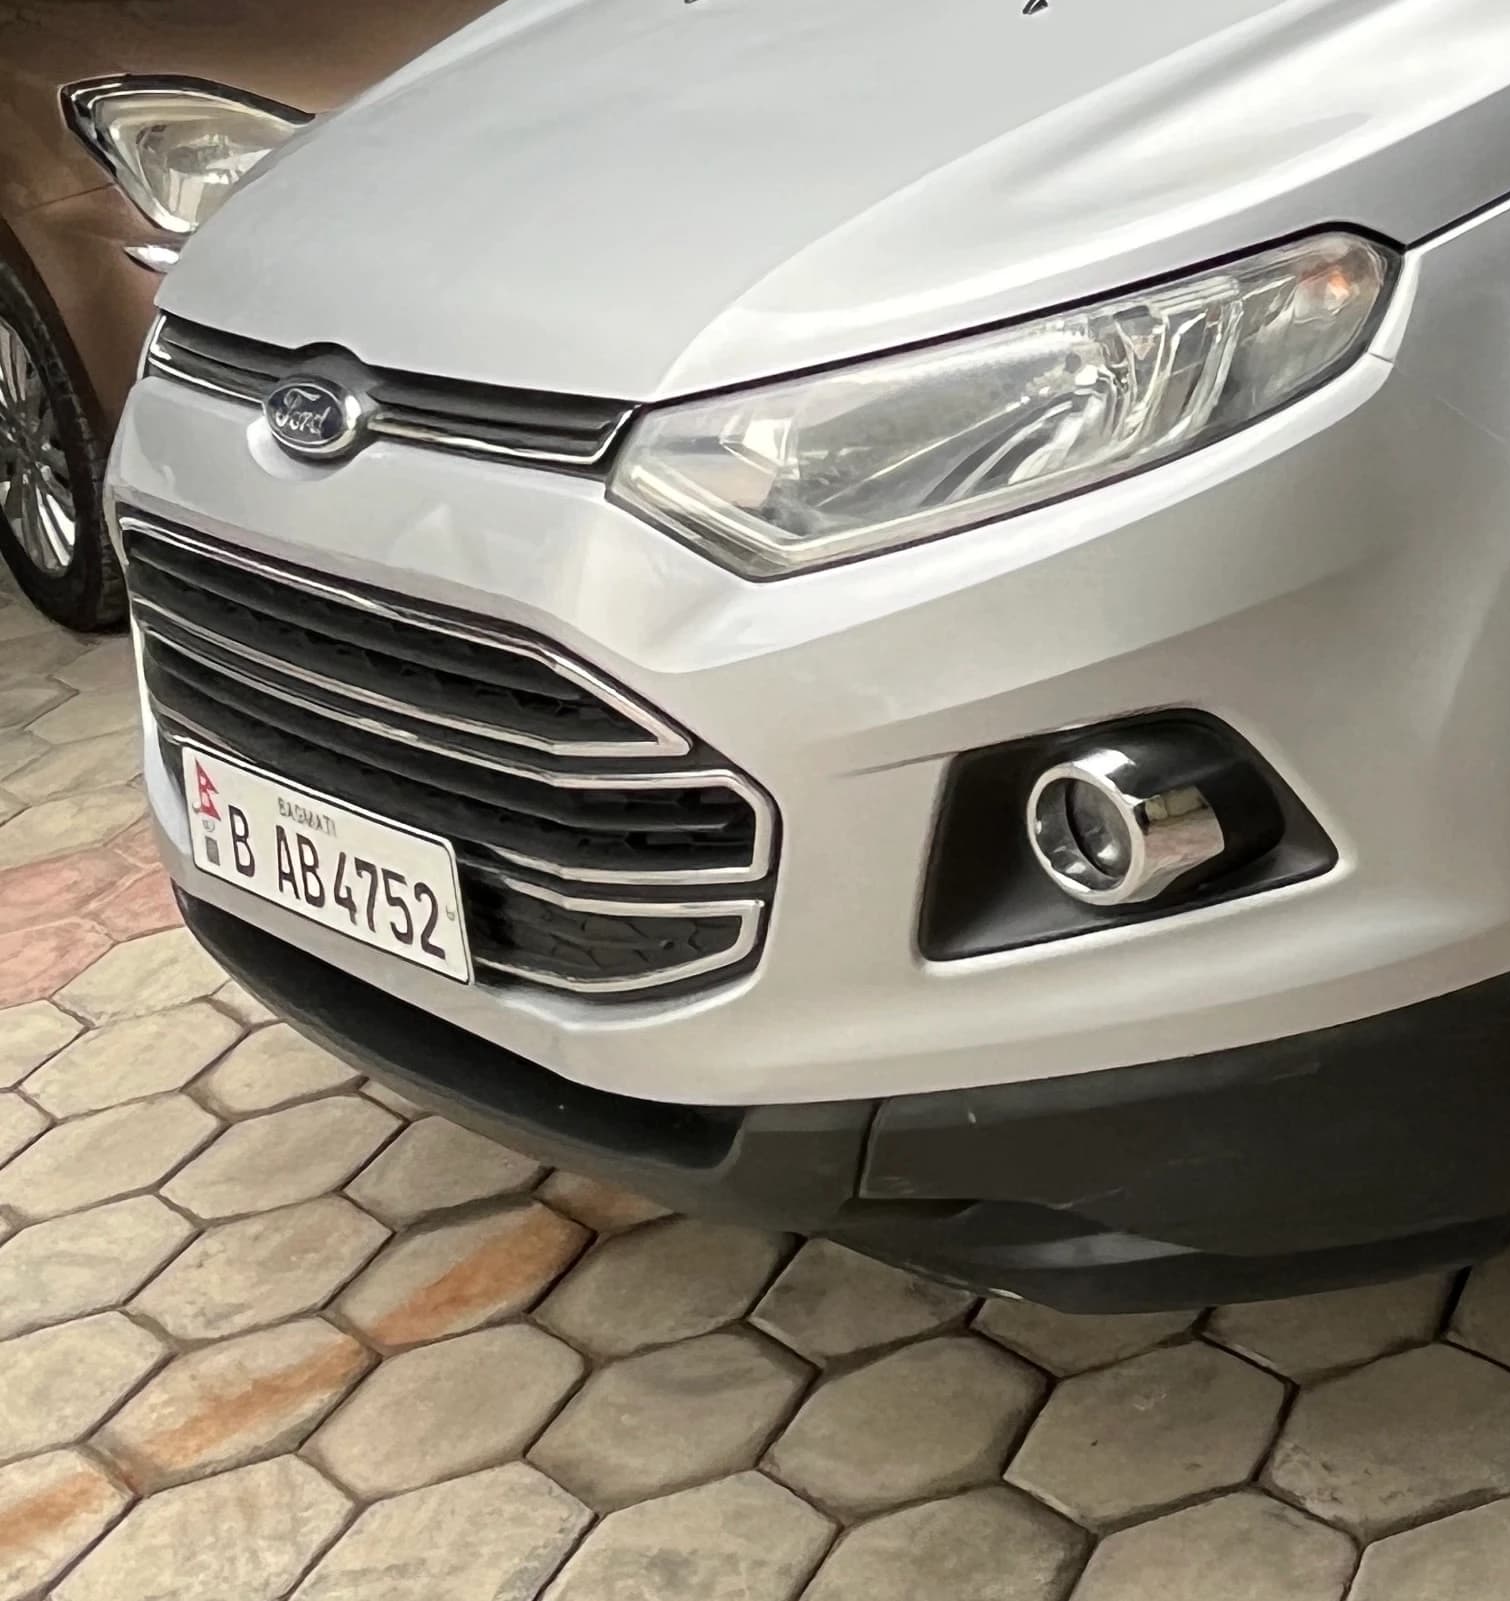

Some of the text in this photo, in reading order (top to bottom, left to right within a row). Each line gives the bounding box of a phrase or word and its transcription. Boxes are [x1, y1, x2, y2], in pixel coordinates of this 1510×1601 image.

[275, 388, 332, 437] Ford
[228, 804, 256, 878] B
[277, 797, 337, 838] BAGMATI
